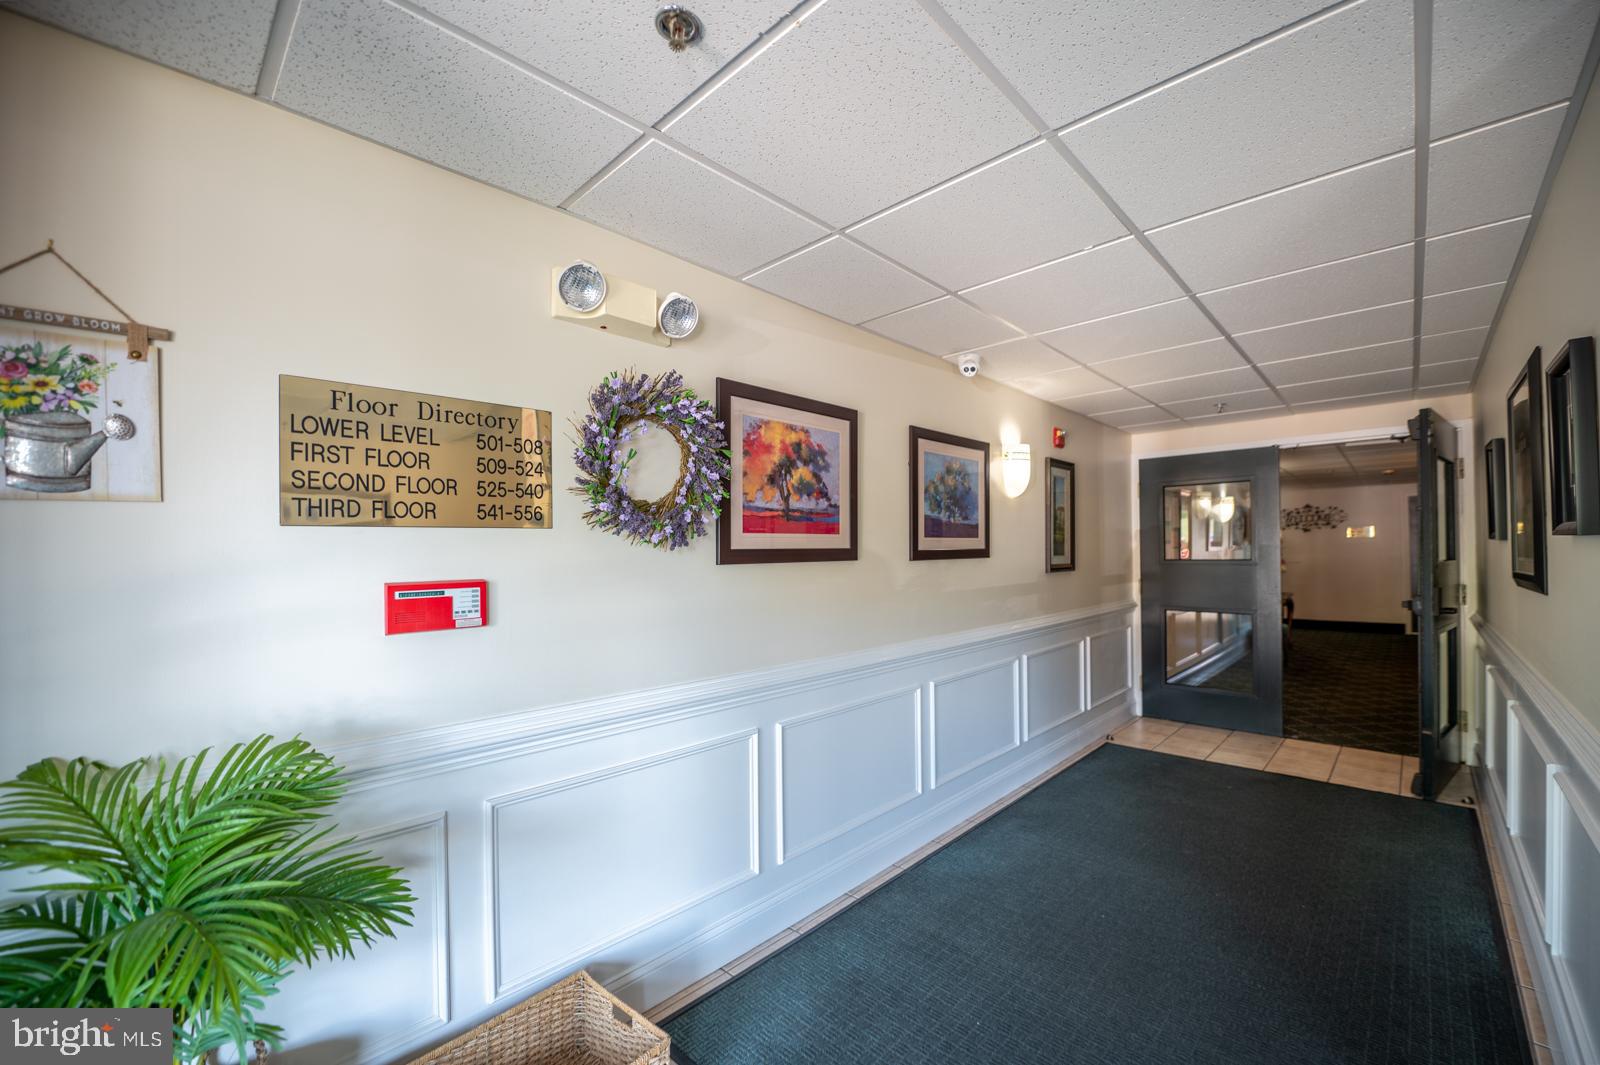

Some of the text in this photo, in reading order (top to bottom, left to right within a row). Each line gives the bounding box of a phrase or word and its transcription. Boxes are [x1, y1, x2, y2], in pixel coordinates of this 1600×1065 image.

[24, 310, 65, 322] GROW
[72, 317, 121, 332] BLOOM
[330, 389, 519, 434] Floor Directory
[291, 413, 543, 455] LOWER LEVEL 501-508
[291, 442, 543, 477] FIRST FLOOR 509-524
[291, 470, 543, 499] SECOND FLOOR 525-540
[292, 497, 543, 521] THIRD FLOOR 541-556
